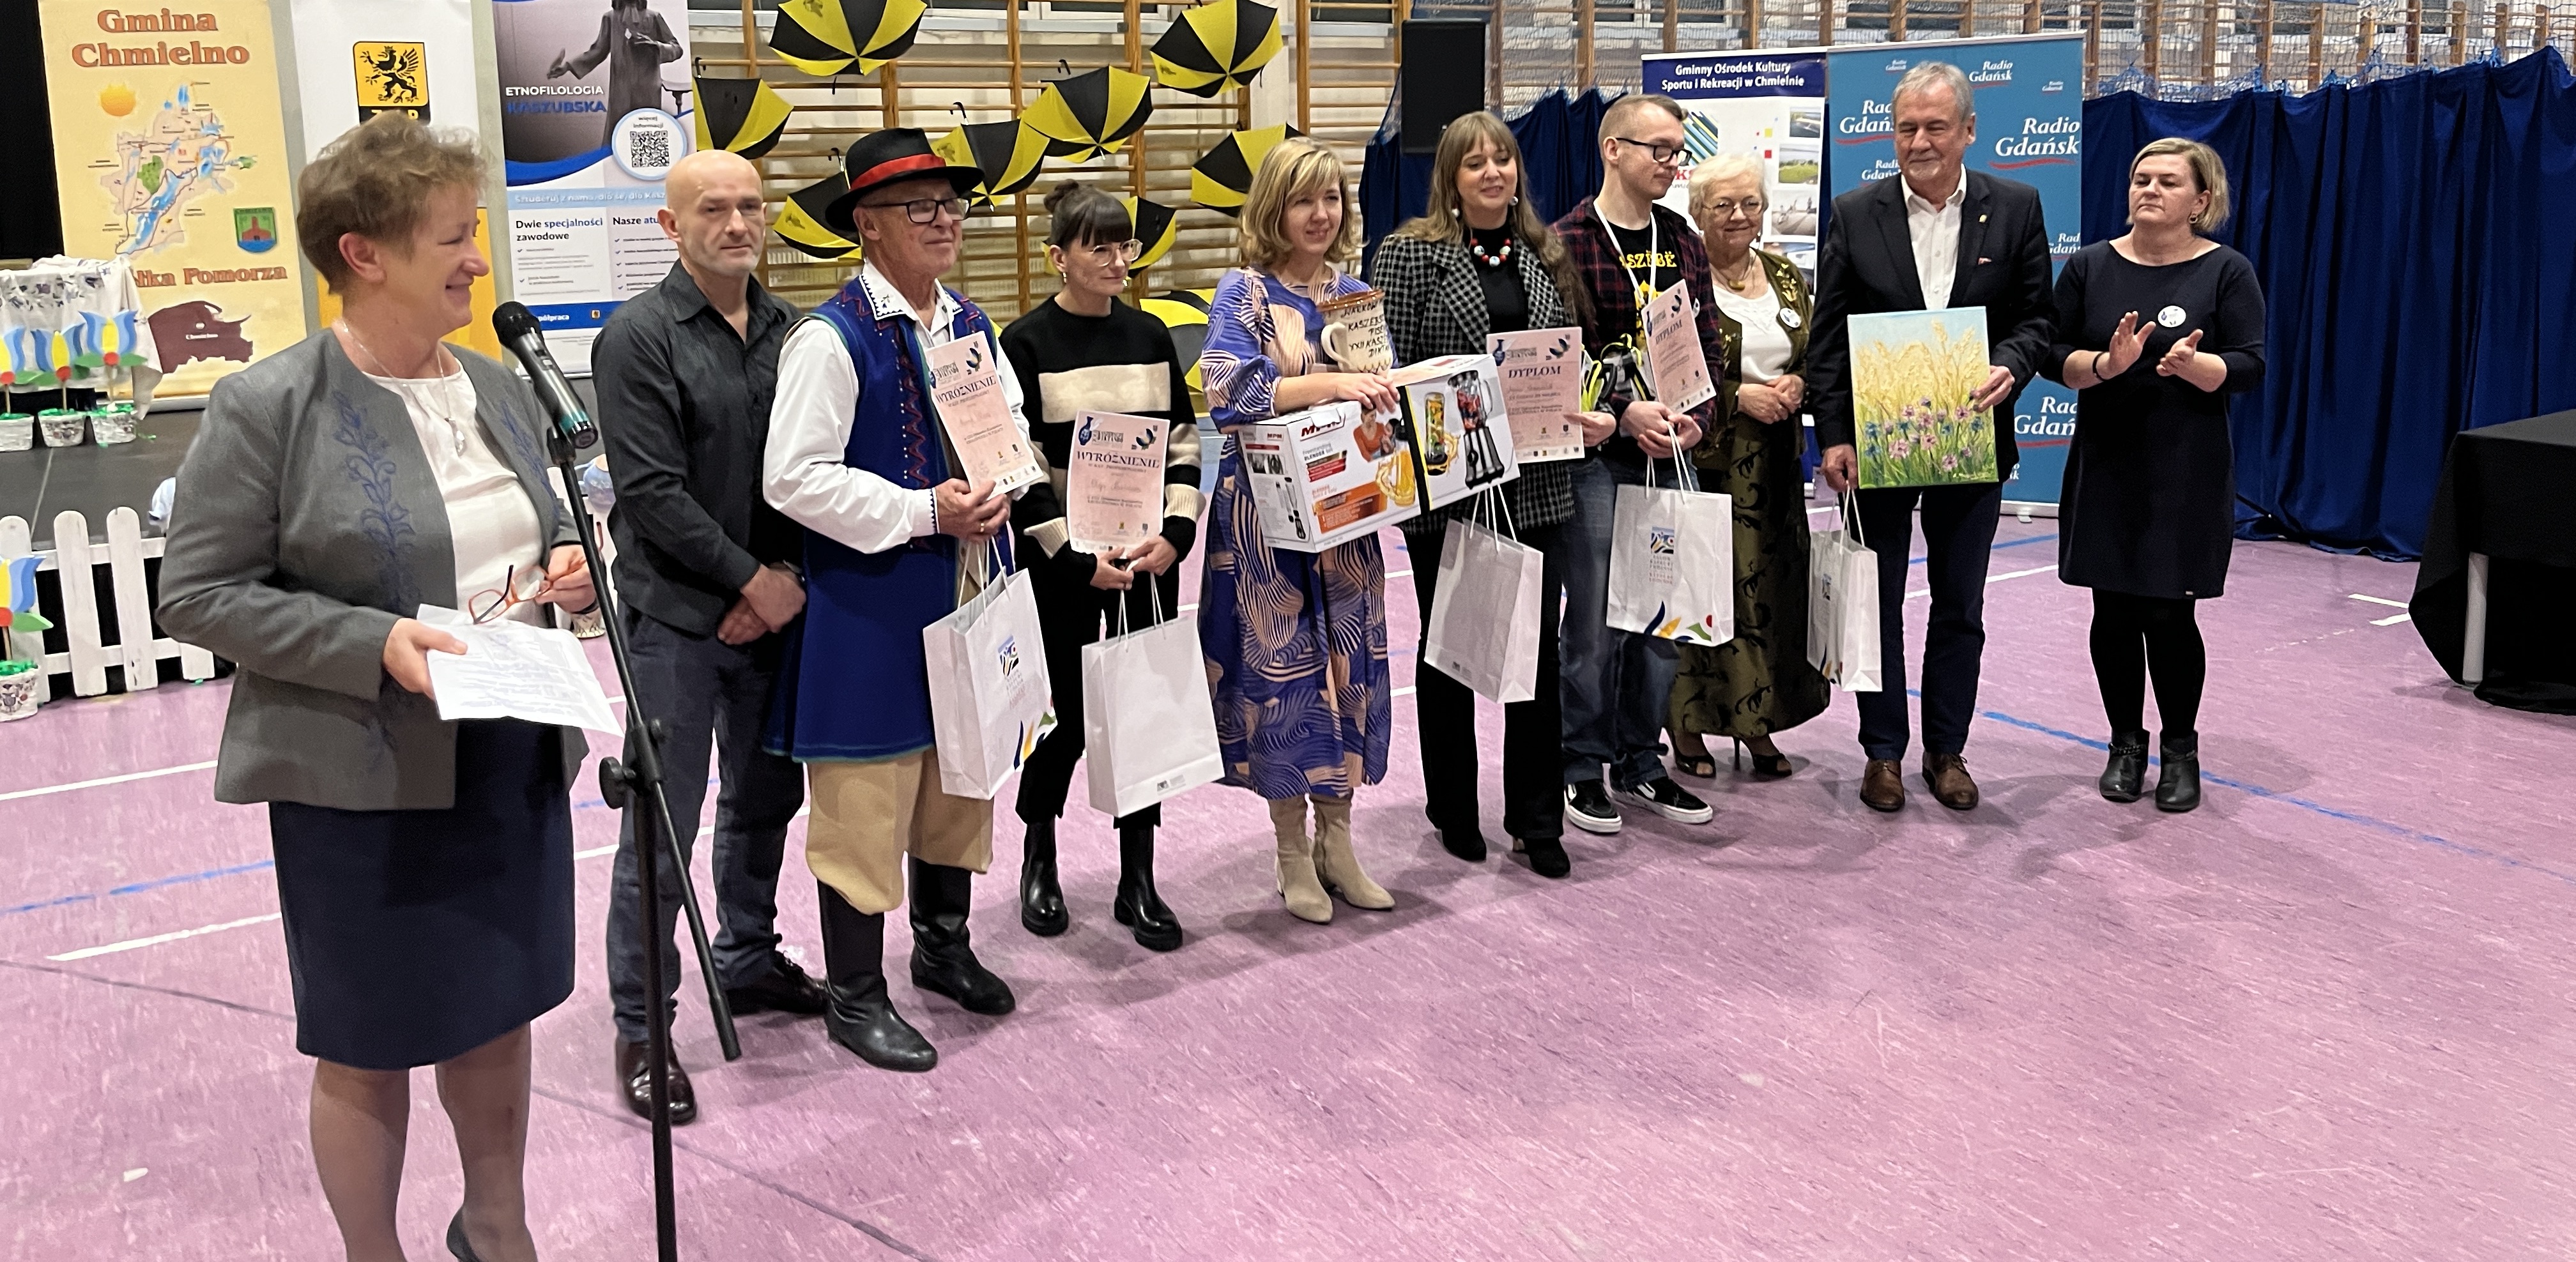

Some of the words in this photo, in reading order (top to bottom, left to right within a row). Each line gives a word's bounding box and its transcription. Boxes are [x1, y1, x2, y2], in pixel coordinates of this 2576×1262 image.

[97, 8, 218, 33] Gmina
[72, 41, 250, 68] Chmielno
[1675, 65, 1713, 77] Gminny
[1714, 61, 1753, 73] Ośrodek
[1756, 61, 1791, 74] Kultury
[1982, 59, 2012, 70] Radio
[1662, 79, 1692, 92] Sportu
[1694, 79, 1698, 89] i
[1700, 77, 1743, 90] Rekreacji
[1755, 75, 1804, 87] Chmielnie
[1969, 70, 2012, 82] Gdańsk
[505, 86, 604, 96] ETNOFILOLOGIA
[507, 100, 606, 114] KASZUBSKA
[2022, 116, 2080, 134] Radio
[1995, 135, 2081, 157] Gdańsk
[516, 220, 541, 229] Dwie
[544, 218, 603, 229] specjalności
[613, 217, 641, 225] Nasze
[517, 232, 569, 241] zawodowe
[183, 266, 288, 285] Pomorza
[1655, 319, 1683, 345] DYPLOM
[1508, 366, 1561, 379] DYPLOM
[935, 375, 997, 404] WYRÓŻNIENIE
[1077, 450, 1160, 469] WYRÓŻNIENIE
